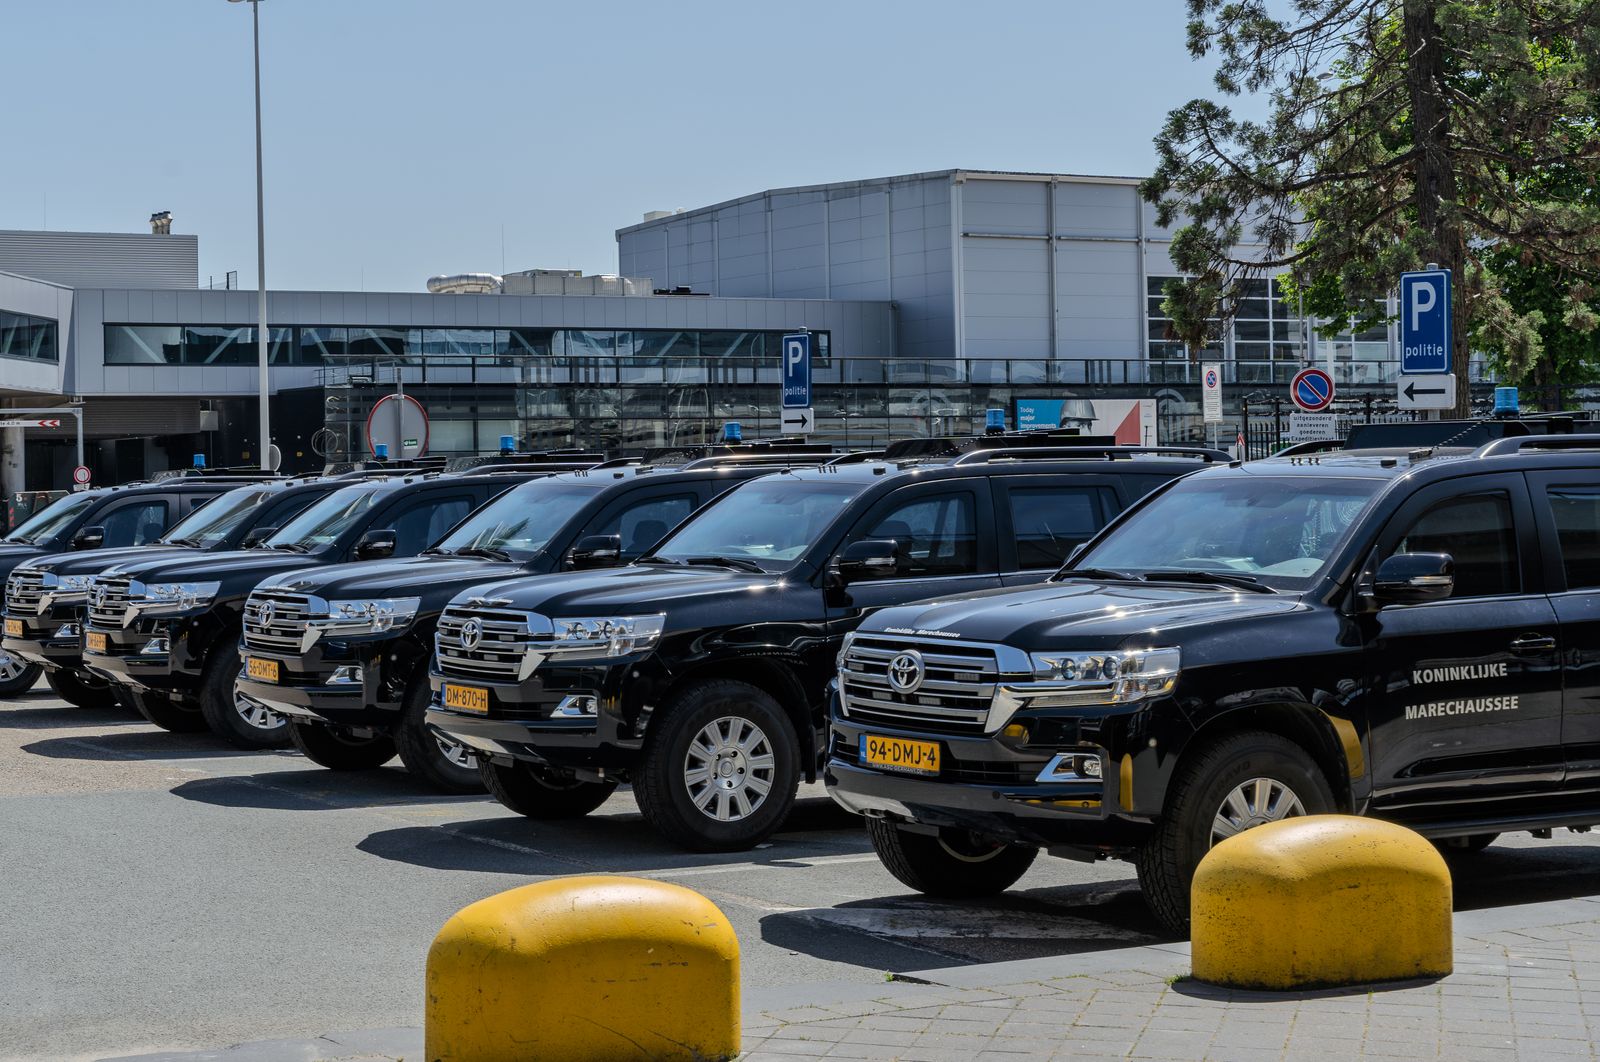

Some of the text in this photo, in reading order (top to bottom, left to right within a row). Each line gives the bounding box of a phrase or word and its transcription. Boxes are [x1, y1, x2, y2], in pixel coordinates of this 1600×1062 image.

[1411, 281, 1437, 331] P
[788, 341, 803, 377] P
[1405, 343, 1443, 359] politie
[784, 385, 807, 396] politie
[1412, 662, 1508, 685] KONINKLIJKE
[446, 687, 487, 709] DM-870-H
[1405, 695, 1519, 720] MARECHAUSSEE
[869, 739, 936, 766] 94-DMJ-4
